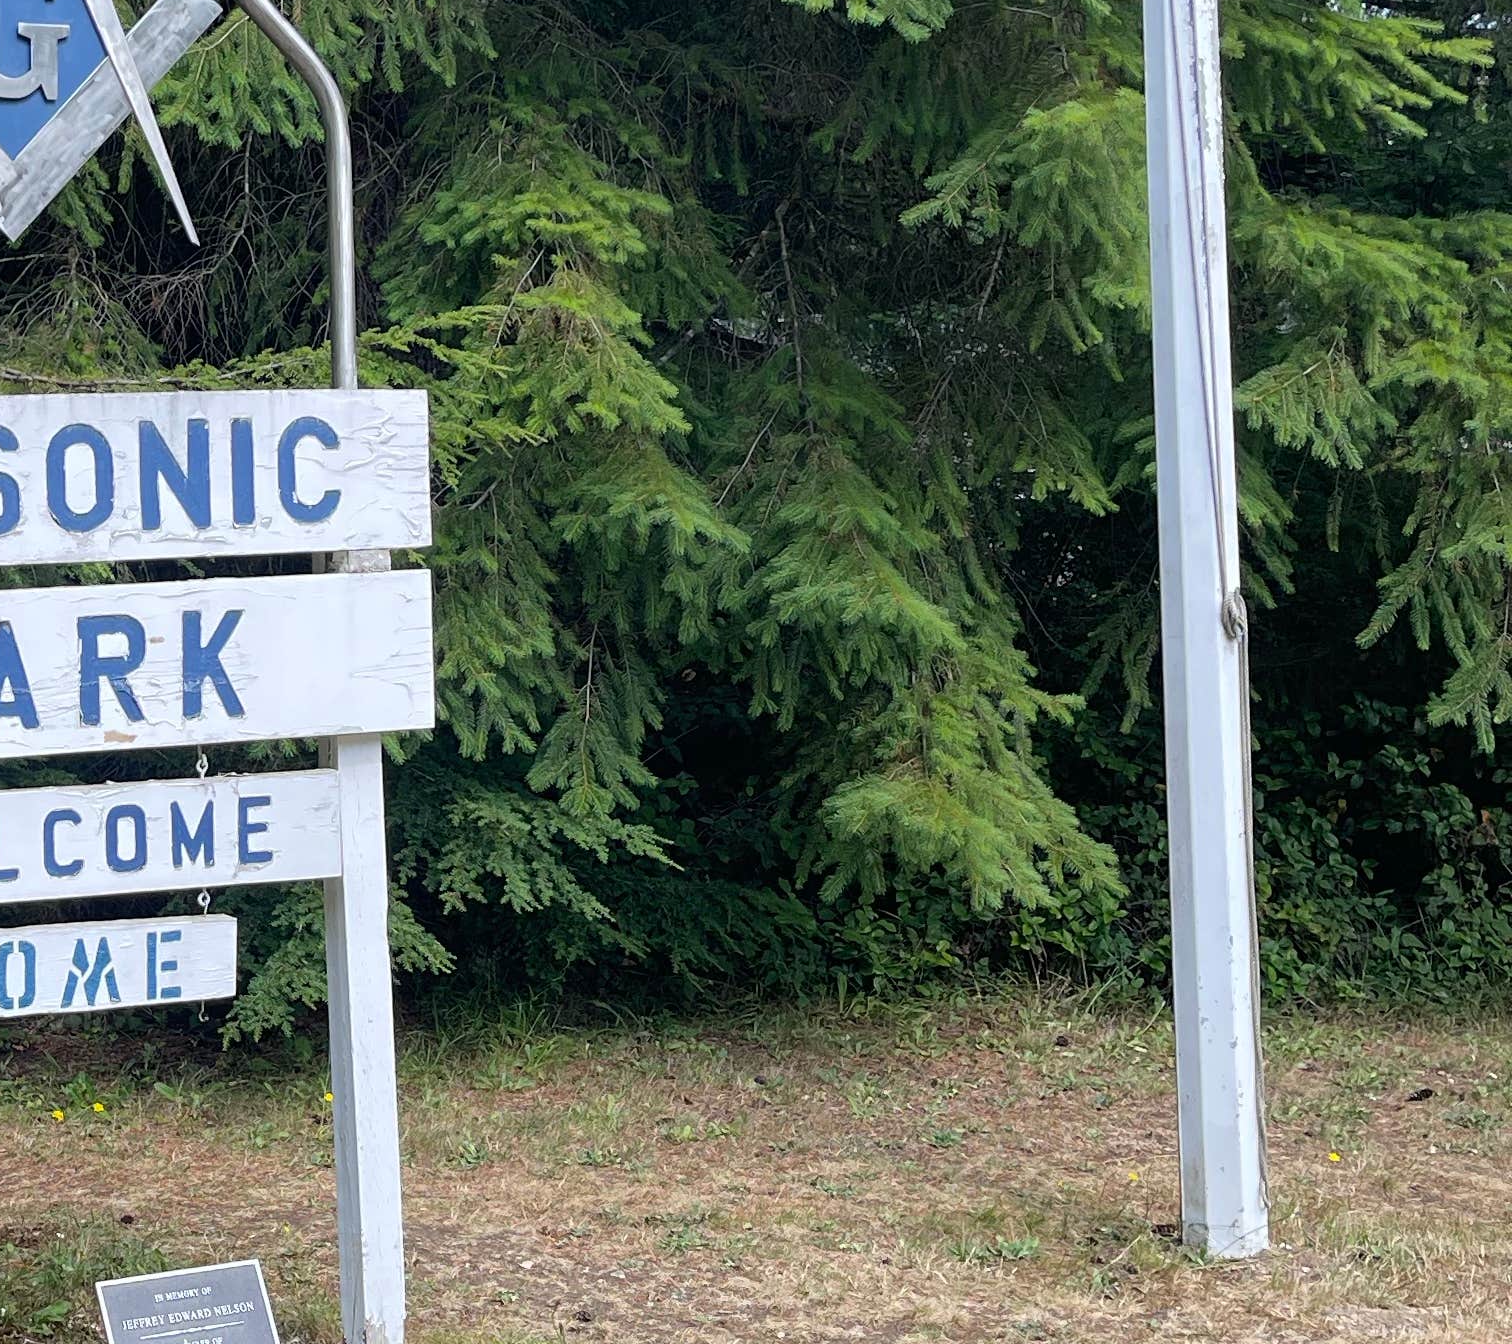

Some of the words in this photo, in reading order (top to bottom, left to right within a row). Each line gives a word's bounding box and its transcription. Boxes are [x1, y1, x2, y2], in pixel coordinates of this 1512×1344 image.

[155, 1293, 164, 1303] IN
[166, 1289, 199, 1301] MEMORY
[202, 1286, 212, 1295] OF
[122, 1315, 165, 1331] JEFFREY
[169, 1308, 212, 1324] EDWARD
[214, 1301, 255, 1316] NELSON
